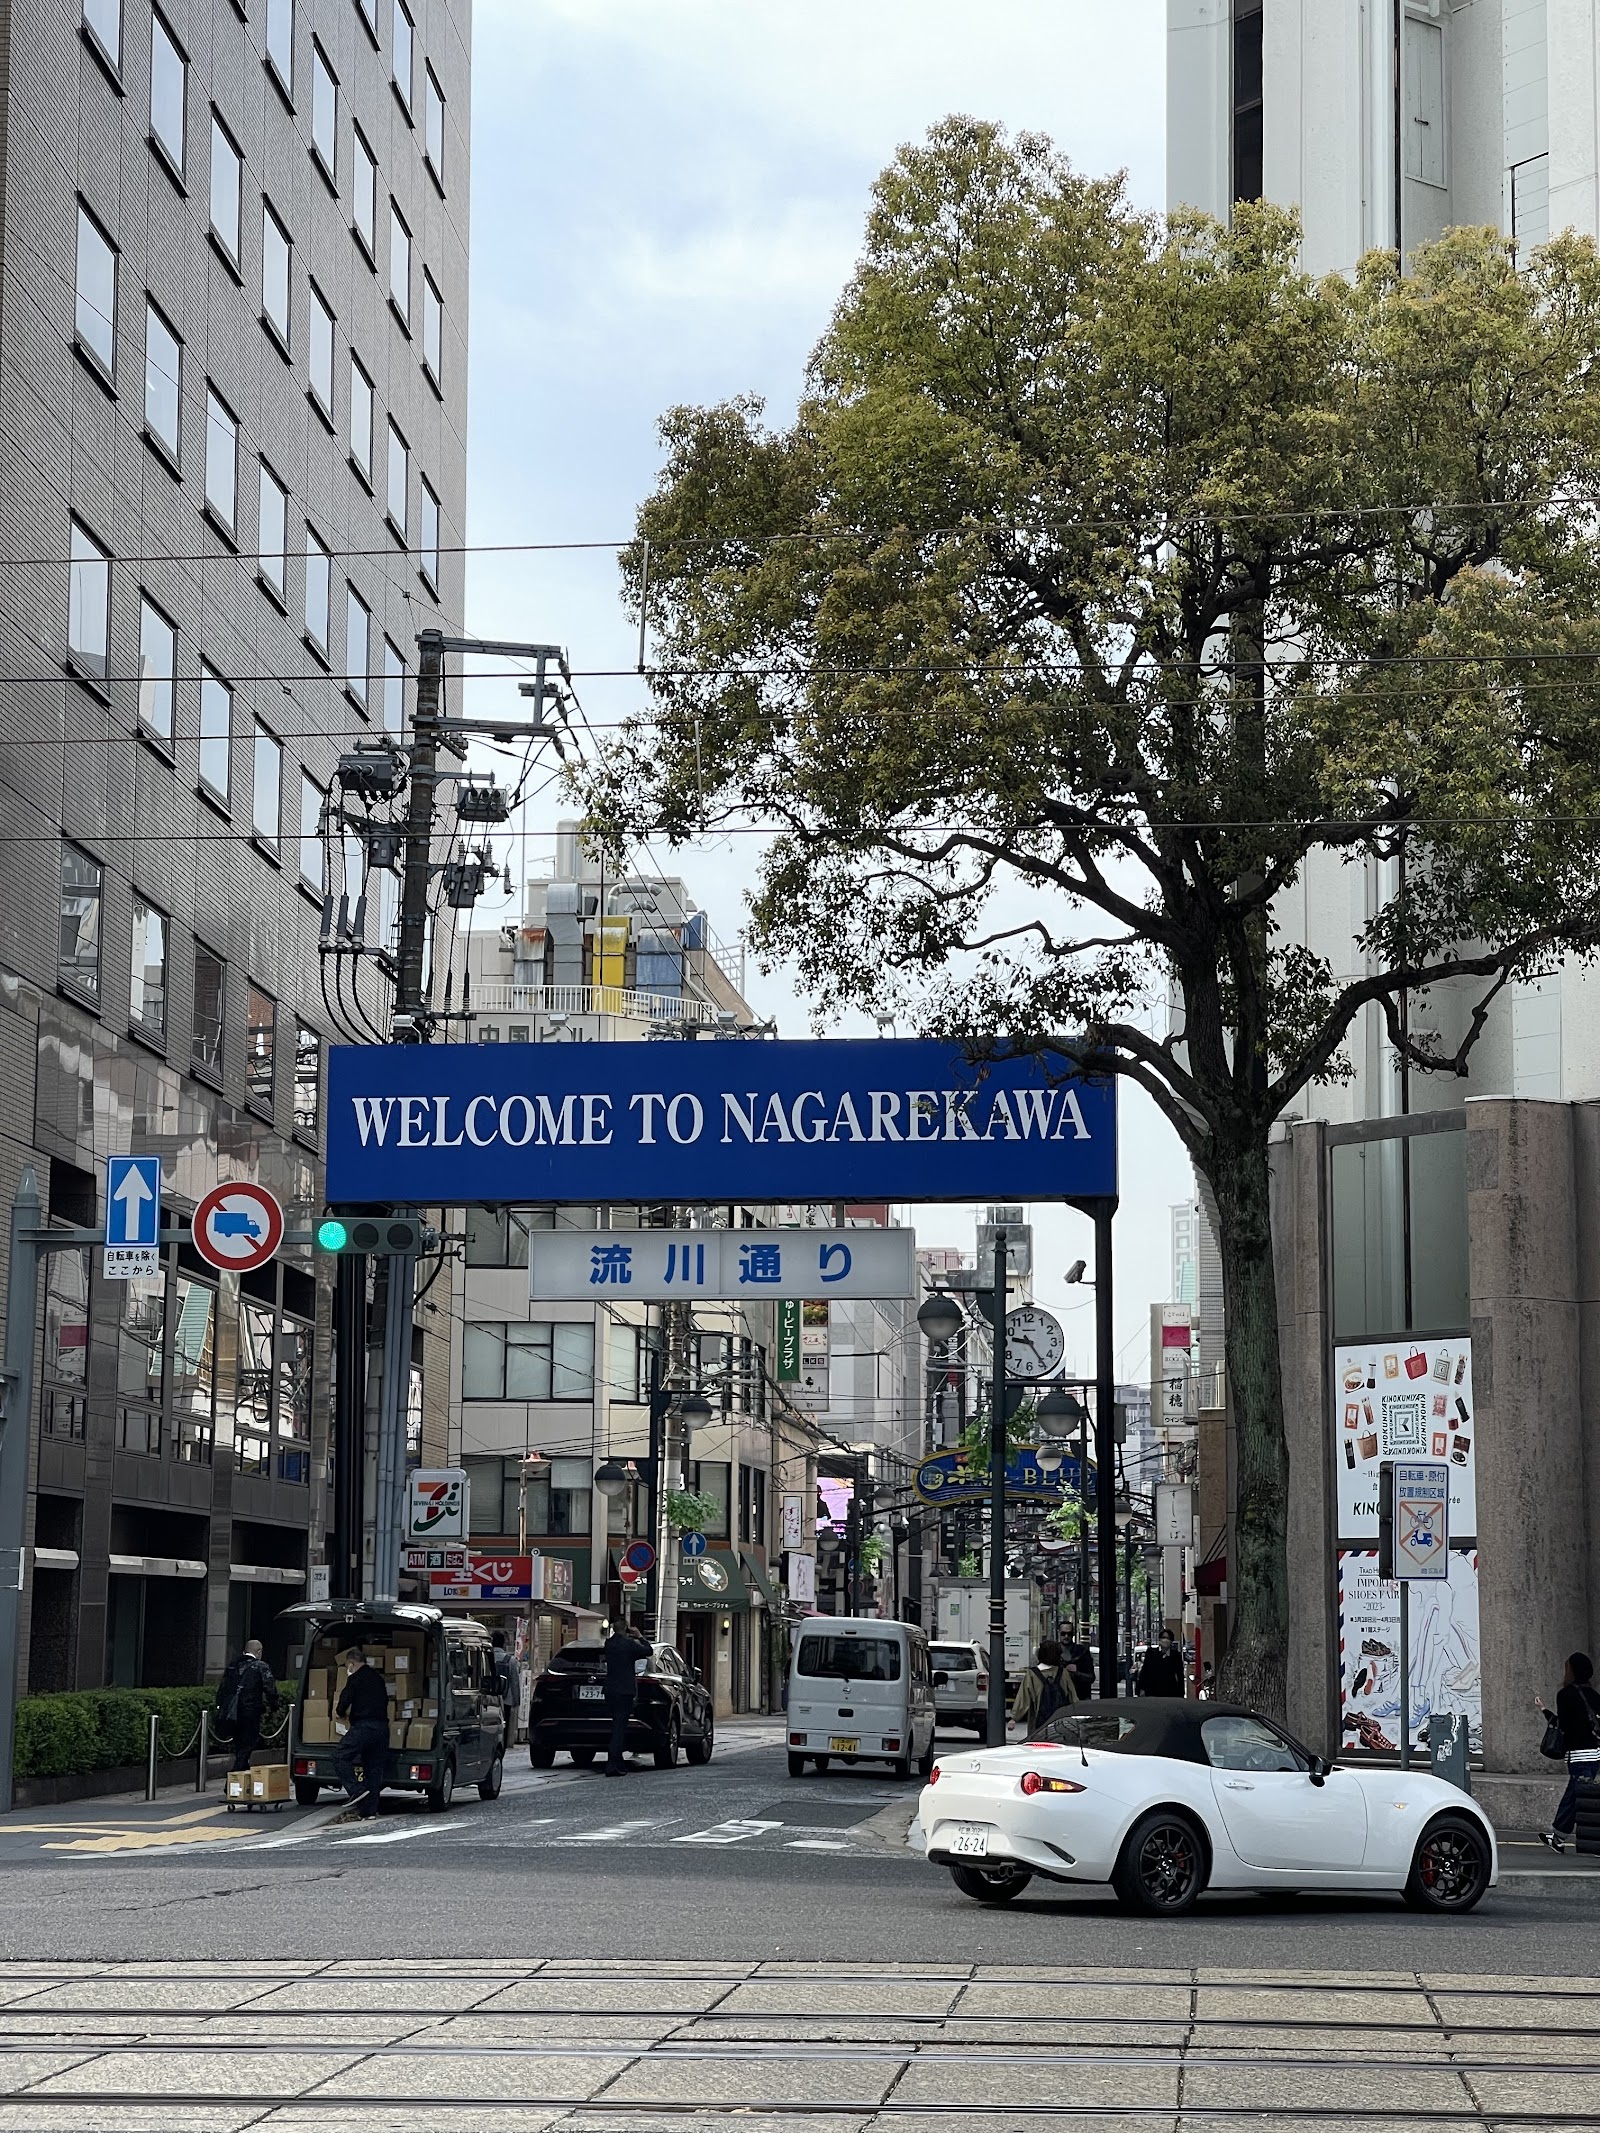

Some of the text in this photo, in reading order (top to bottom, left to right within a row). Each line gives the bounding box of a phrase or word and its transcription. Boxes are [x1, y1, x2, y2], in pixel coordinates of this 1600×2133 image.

[352, 1089, 1092, 1148] WELCOME TO NAGAREKAWA
[107, 1250, 155, 1262] 自転車を除く
[589, 1242, 854, 1286] 流川通り
[107, 1265, 155, 1276] ここから
[1382, 1394, 1420, 1403] KINOKUNIYA
[1419, 1394, 1427, 1447] KINOKUNIYA
[408, 1553, 425, 1566] ATM
[429, 1553, 442, 1567] 酒
[1357, 1578, 1389, 1588] IMPORT
[1348, 1590, 1400, 1600] SHOES FAIR
[585, 1690, 603, 1699] 23-7
[836, 1743, 856, 1752] 12-41
[958, 1836, 984, 1853] 26-24
